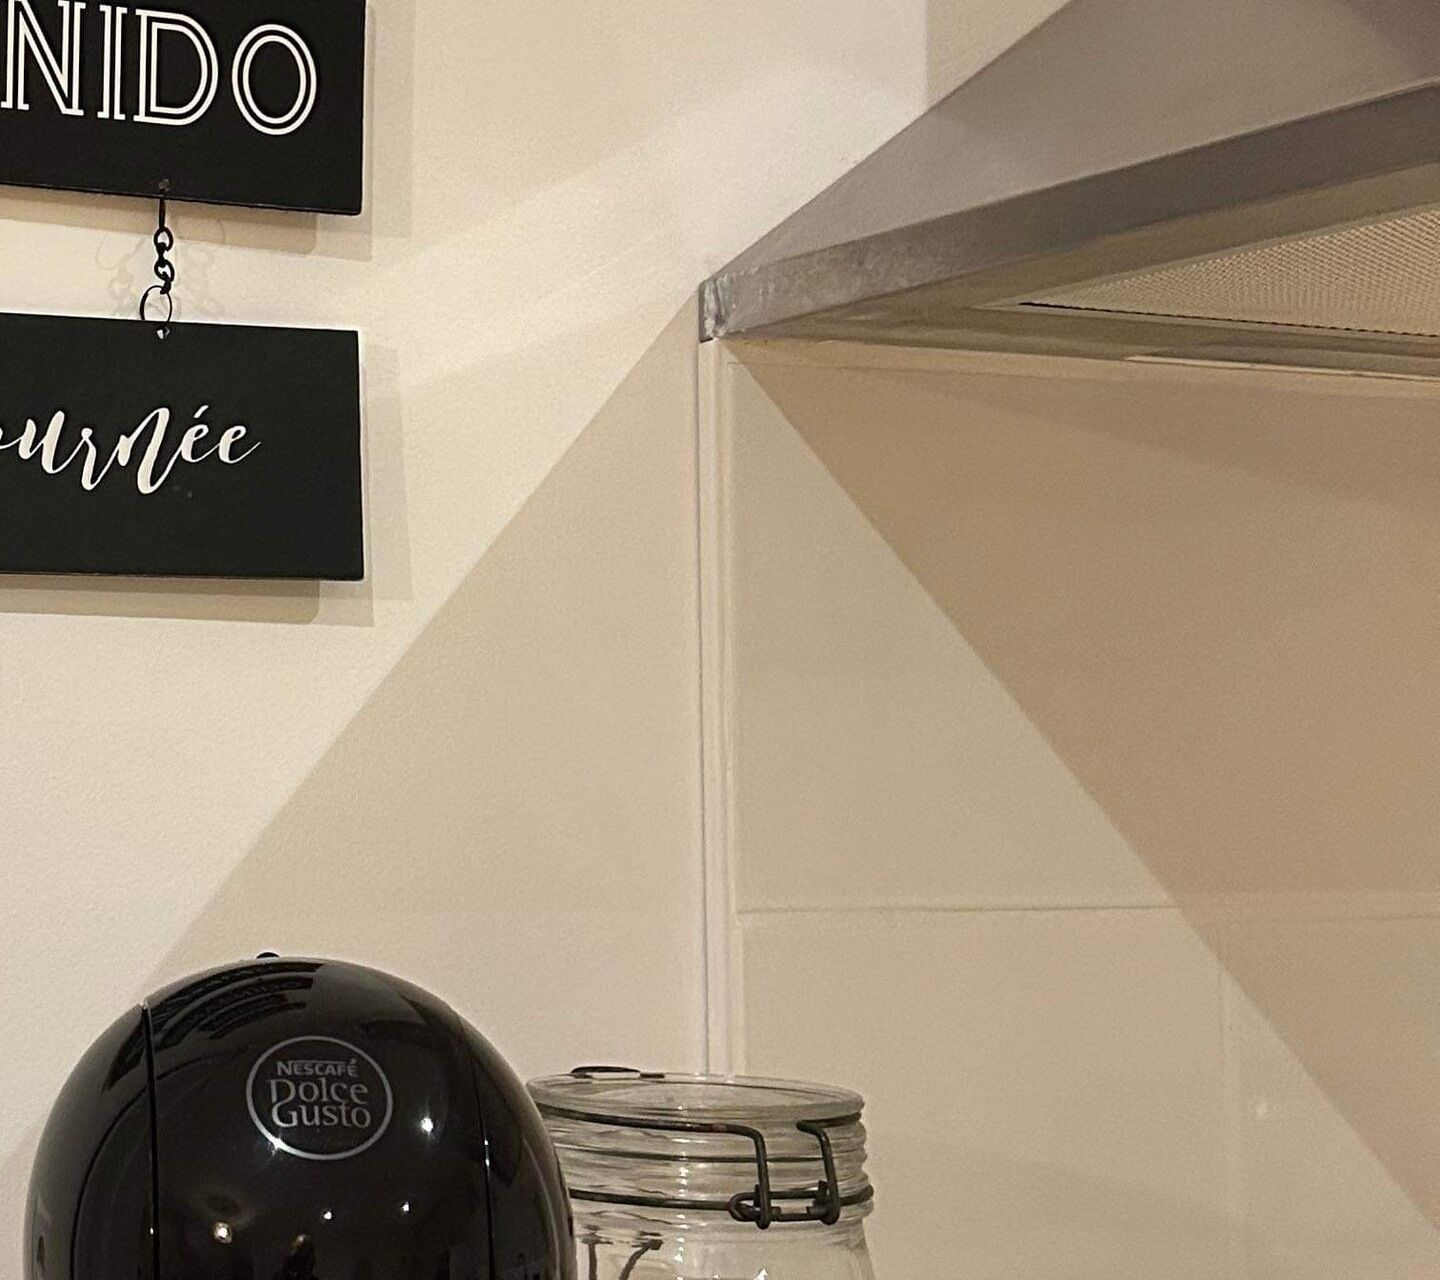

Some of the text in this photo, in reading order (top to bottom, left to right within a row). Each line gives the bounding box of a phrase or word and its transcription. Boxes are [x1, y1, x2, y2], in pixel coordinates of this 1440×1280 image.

[276, 1058, 359, 1078] NESCAFÉ
[267, 1077, 369, 1105] Dolce
[271, 1101, 372, 1129] Gusto
